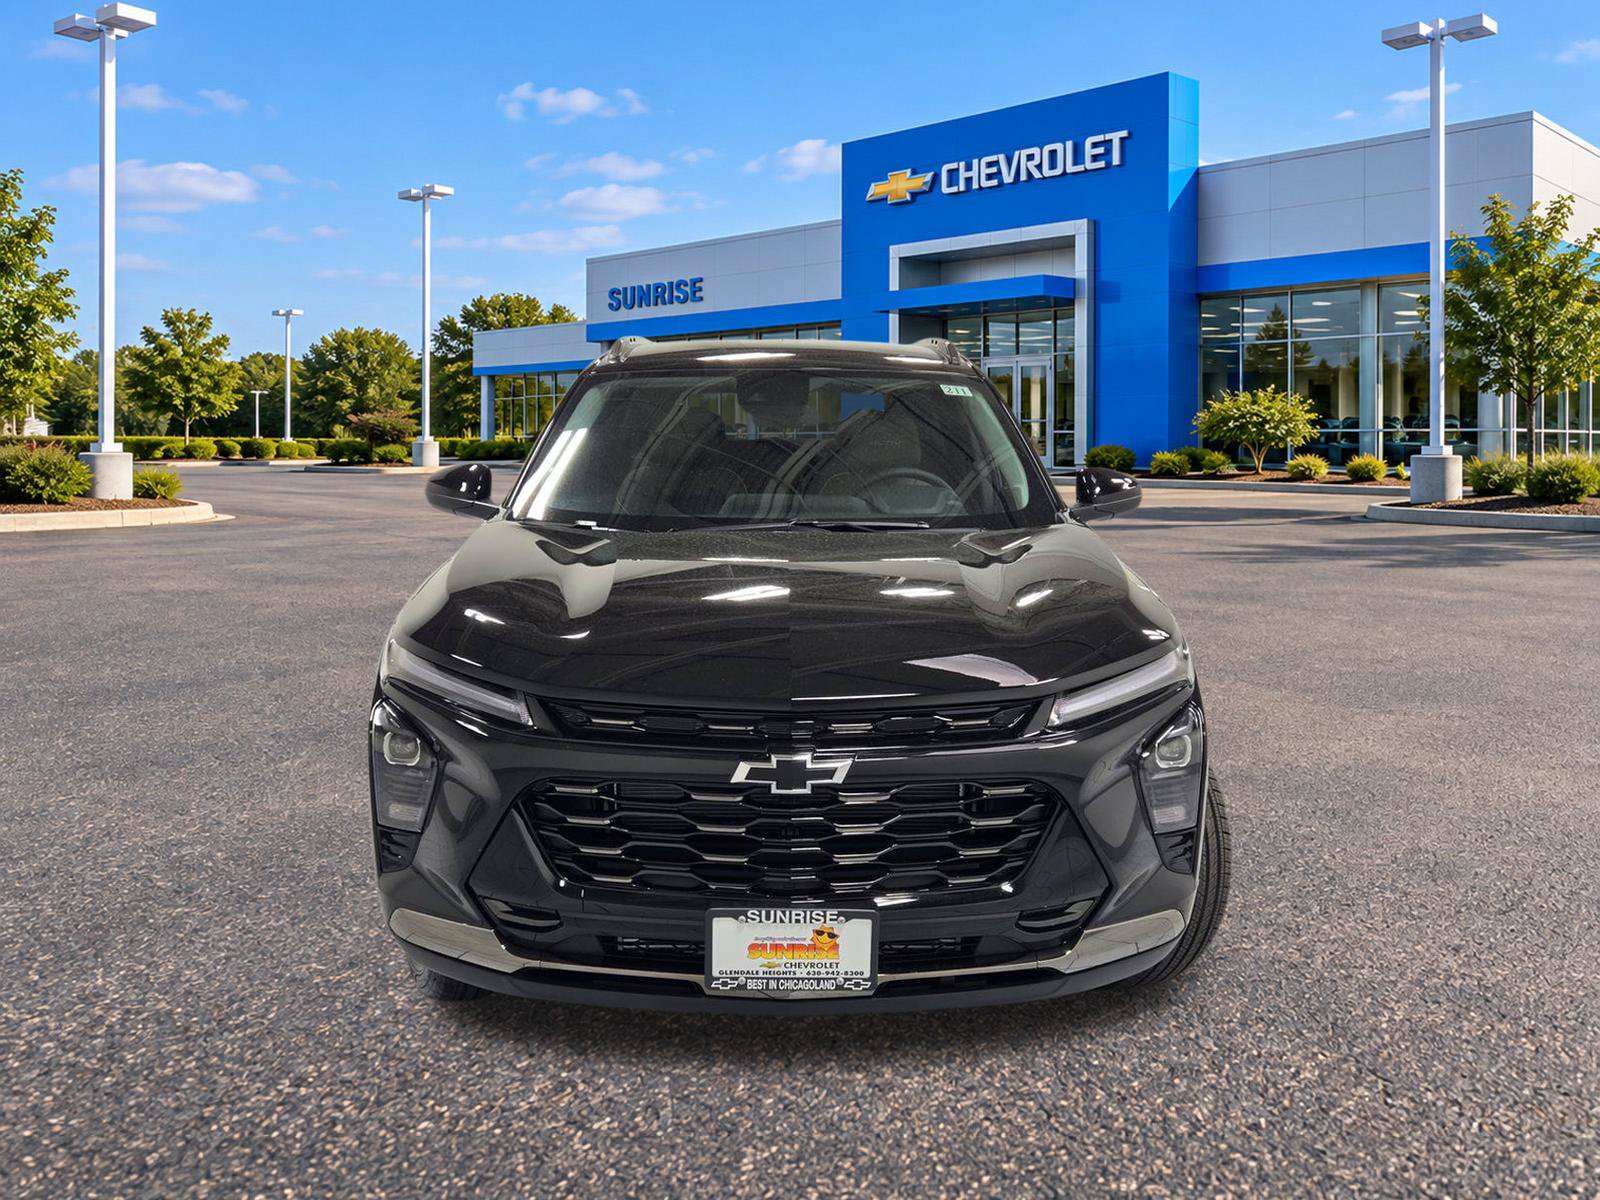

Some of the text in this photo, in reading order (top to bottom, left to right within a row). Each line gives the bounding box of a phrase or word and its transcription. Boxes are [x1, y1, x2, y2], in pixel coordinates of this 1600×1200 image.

[941, 130, 1129, 195] CHEVROLET
[608, 277, 704, 312] SUNRISE
[746, 909, 838, 924] SUNRISE
[783, 961, 840, 969] CHEVROLET
[746, 979, 836, 990] BEST IN CHICAGOLAND
